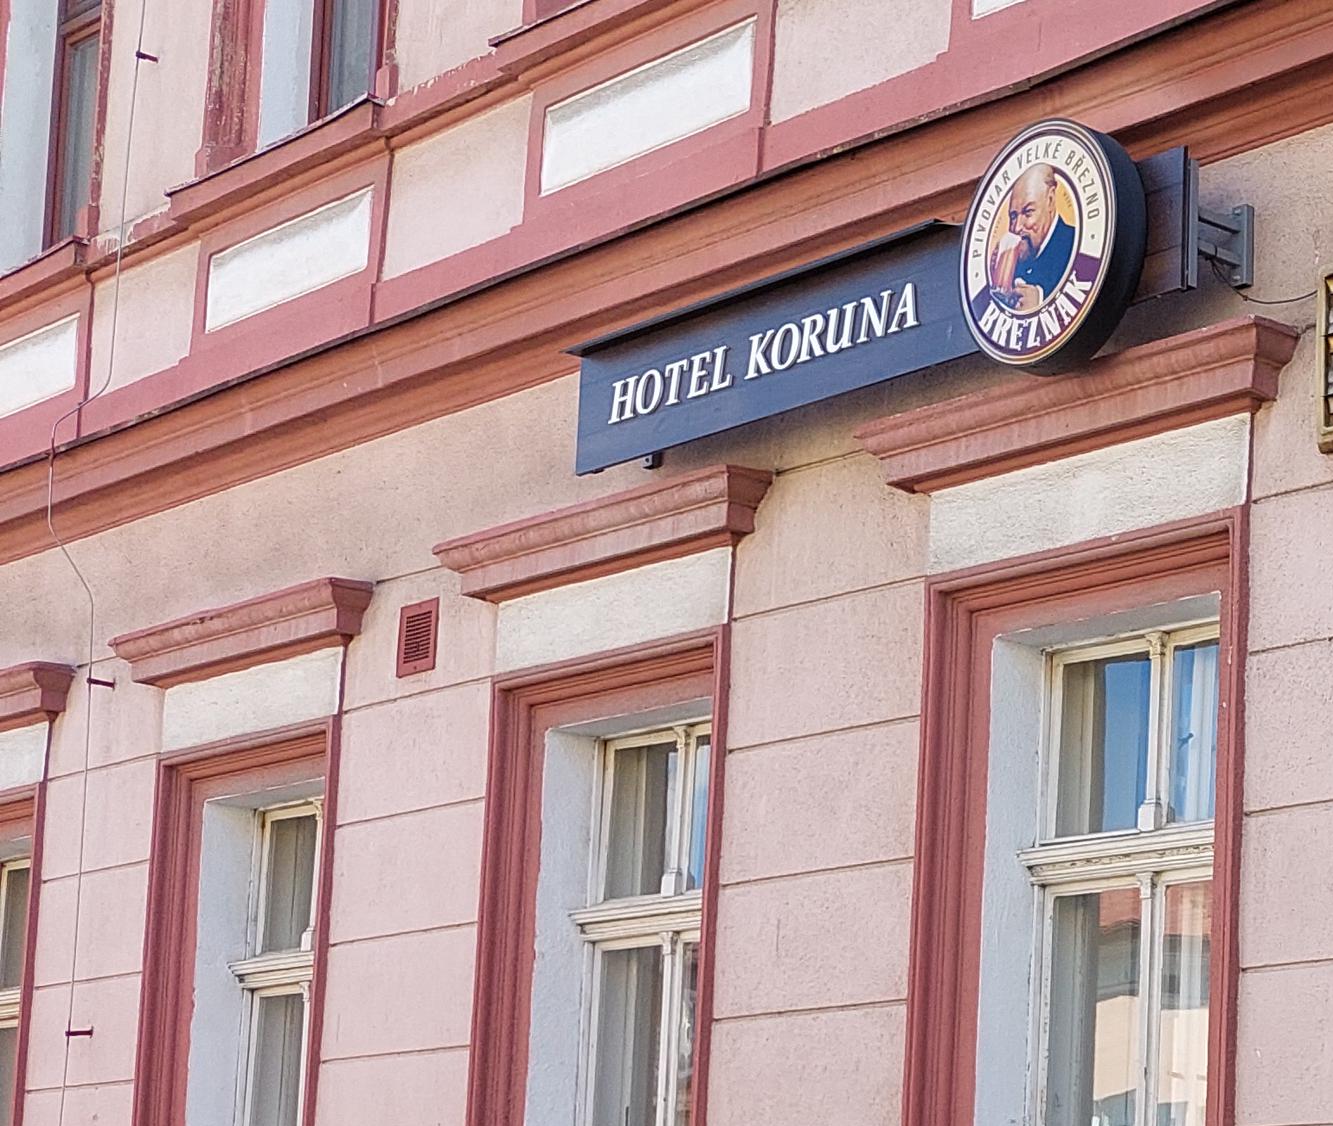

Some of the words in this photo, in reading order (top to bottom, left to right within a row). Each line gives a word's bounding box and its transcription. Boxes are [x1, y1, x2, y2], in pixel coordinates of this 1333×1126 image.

[972, 169, 1011, 259] PIVOVAR
[1016, 140, 1063, 170] VELKÉ
[1065, 150, 1100, 220] BŘEZNO
[607, 345, 733, 424] HOTEL
[744, 282, 920, 380] KORUNA
[978, 271, 1092, 351] BŘEZŇÁK
